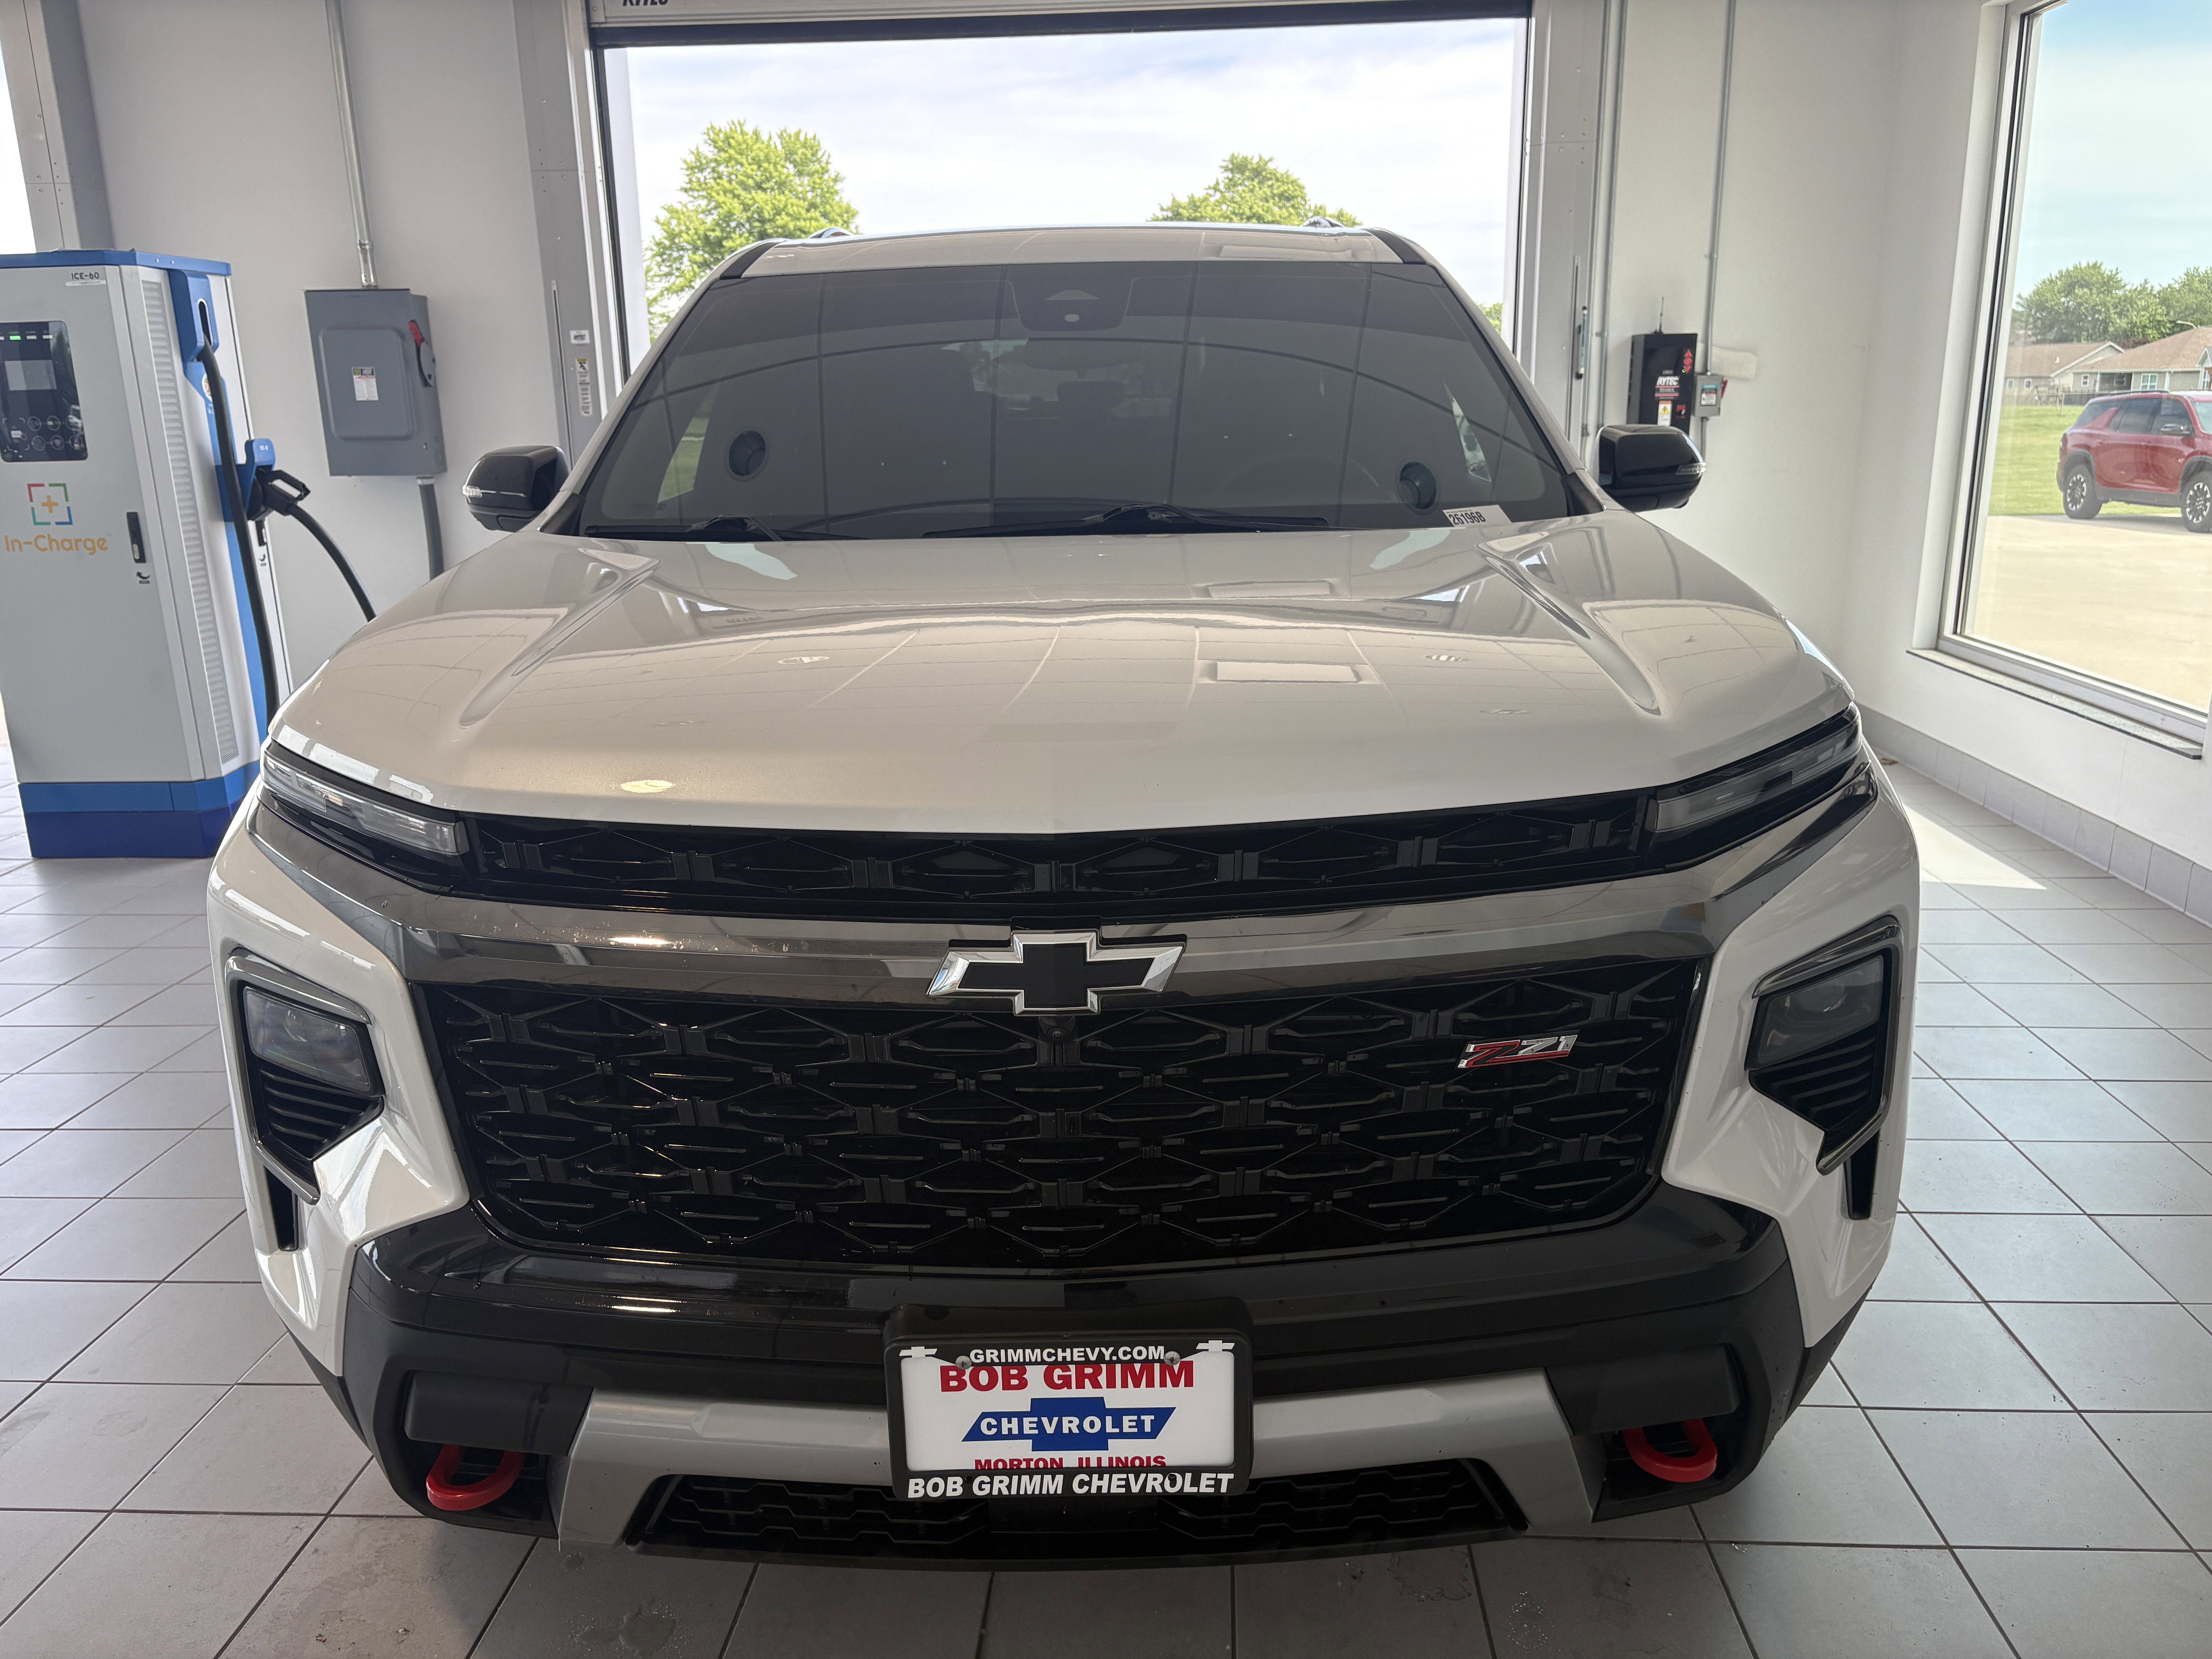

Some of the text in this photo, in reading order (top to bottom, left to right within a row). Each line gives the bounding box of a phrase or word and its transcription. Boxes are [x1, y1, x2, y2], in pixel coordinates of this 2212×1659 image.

[4, 534, 108, 556] In-Charge
[1457, 1035, 1578, 1068] Z71
[970, 1346, 1164, 1363] GRIMMCHEVY.COM
[940, 1360, 1194, 1392] BOB GRIMM
[980, 1415, 1154, 1435] CHEVROLET
[975, 1457, 1063, 1470] MORTON
[908, 1473, 1234, 1498] BOB GRIMM CHEVROLET
